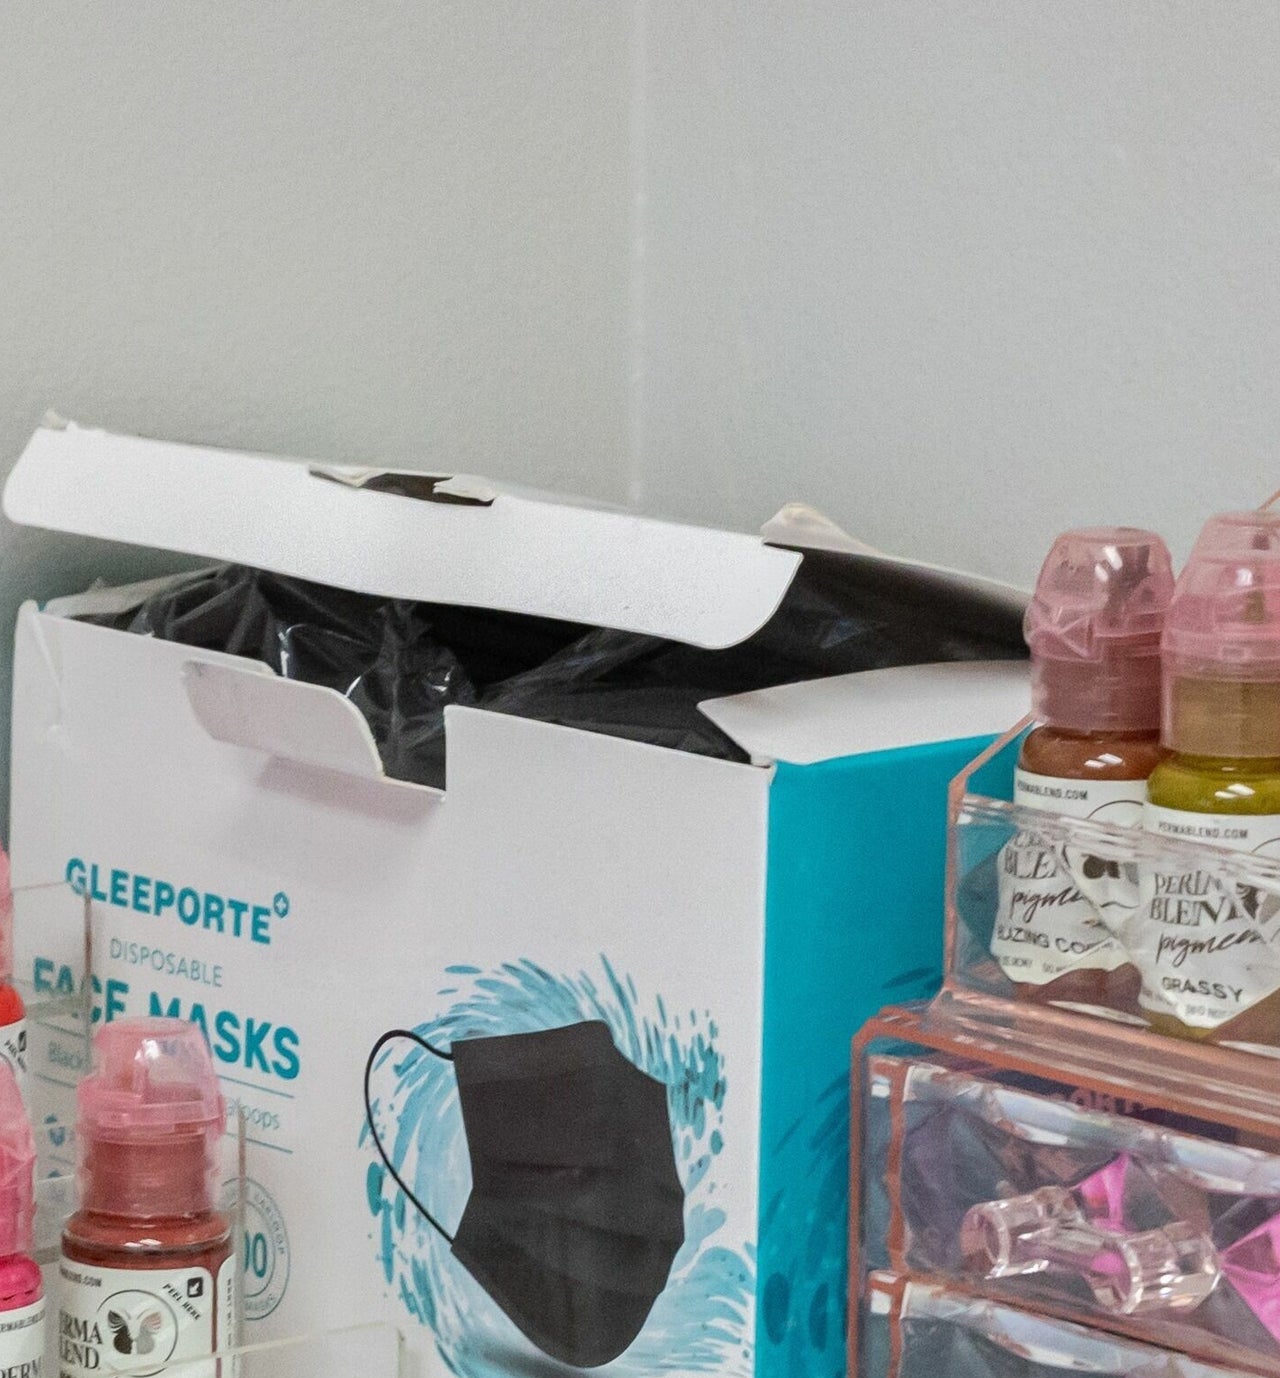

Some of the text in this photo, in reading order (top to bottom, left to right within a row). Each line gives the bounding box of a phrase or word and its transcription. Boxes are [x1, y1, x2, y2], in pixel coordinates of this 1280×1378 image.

[64, 857, 272, 945] GLEEPORTE
[109, 938, 224, 988] DISPOSABLE
[1161, 976, 1244, 1003] GRASSY
